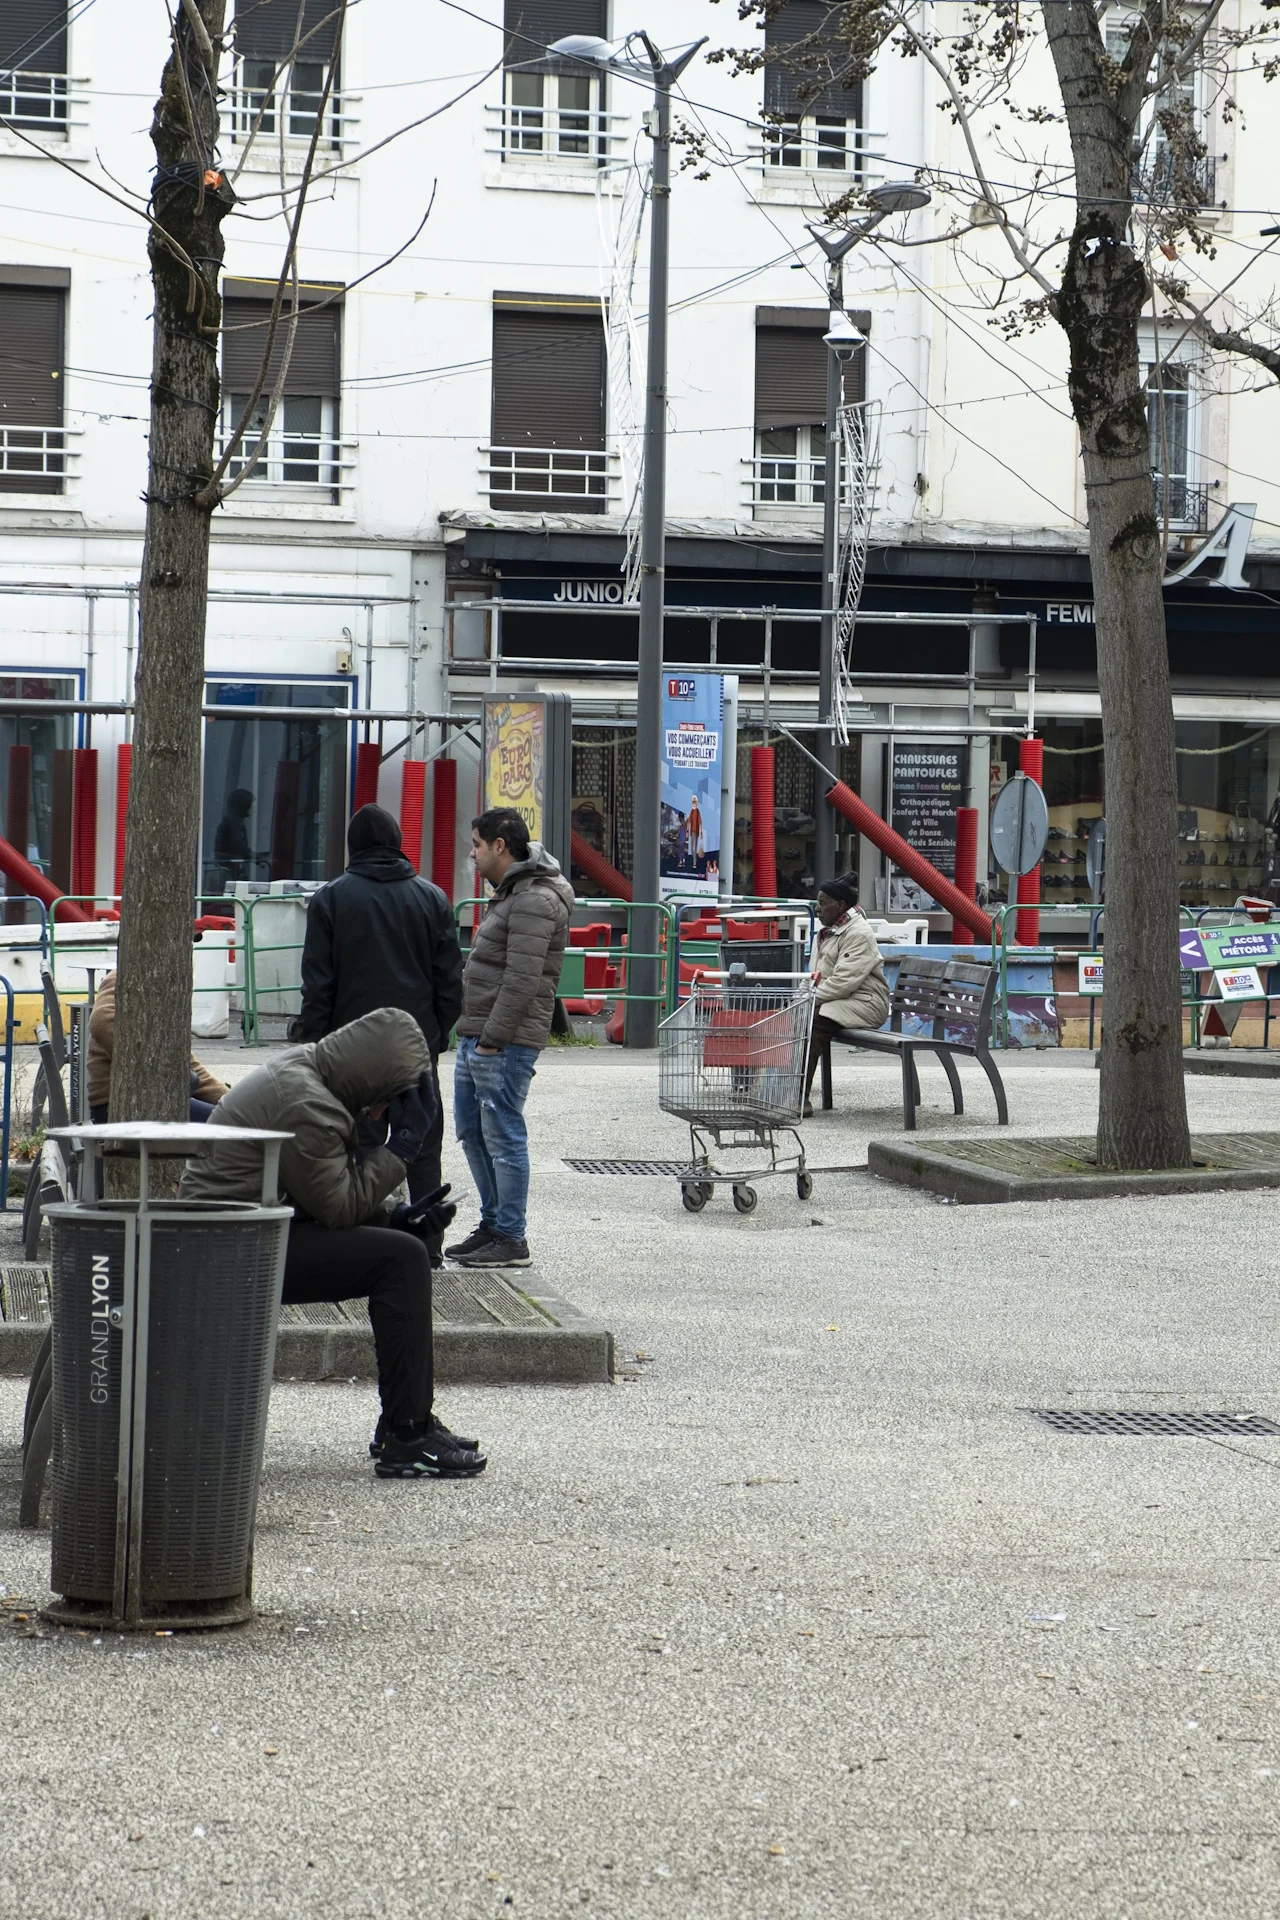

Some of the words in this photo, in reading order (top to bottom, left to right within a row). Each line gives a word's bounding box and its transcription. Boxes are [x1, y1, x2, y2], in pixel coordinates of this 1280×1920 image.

[1046, 603, 1096, 623] FEM
[667, 733, 678, 744] VOS
[678, 733, 717, 747] COMMERÇANTS
[501, 738, 531, 765] EURO
[668, 746, 682, 757] VOUS
[682, 747, 715, 759] ACCUEILLENT
[894, 754, 958, 765] CHAUSSURES
[502, 762, 531, 790] PARC
[894, 767, 958, 778] PANTOUFLES
[916, 782, 940, 790] Femme
[941, 783, 962, 791] Enfant
[900, 798, 951, 807] Orthopédique
[893, 808, 919, 816] Confort
[911, 818, 921, 826] de
[923, 818, 939, 826] Ville
[1234, 935, 1264, 944] ACCÈS
[1221, 945, 1268, 956] PIÉTONS
